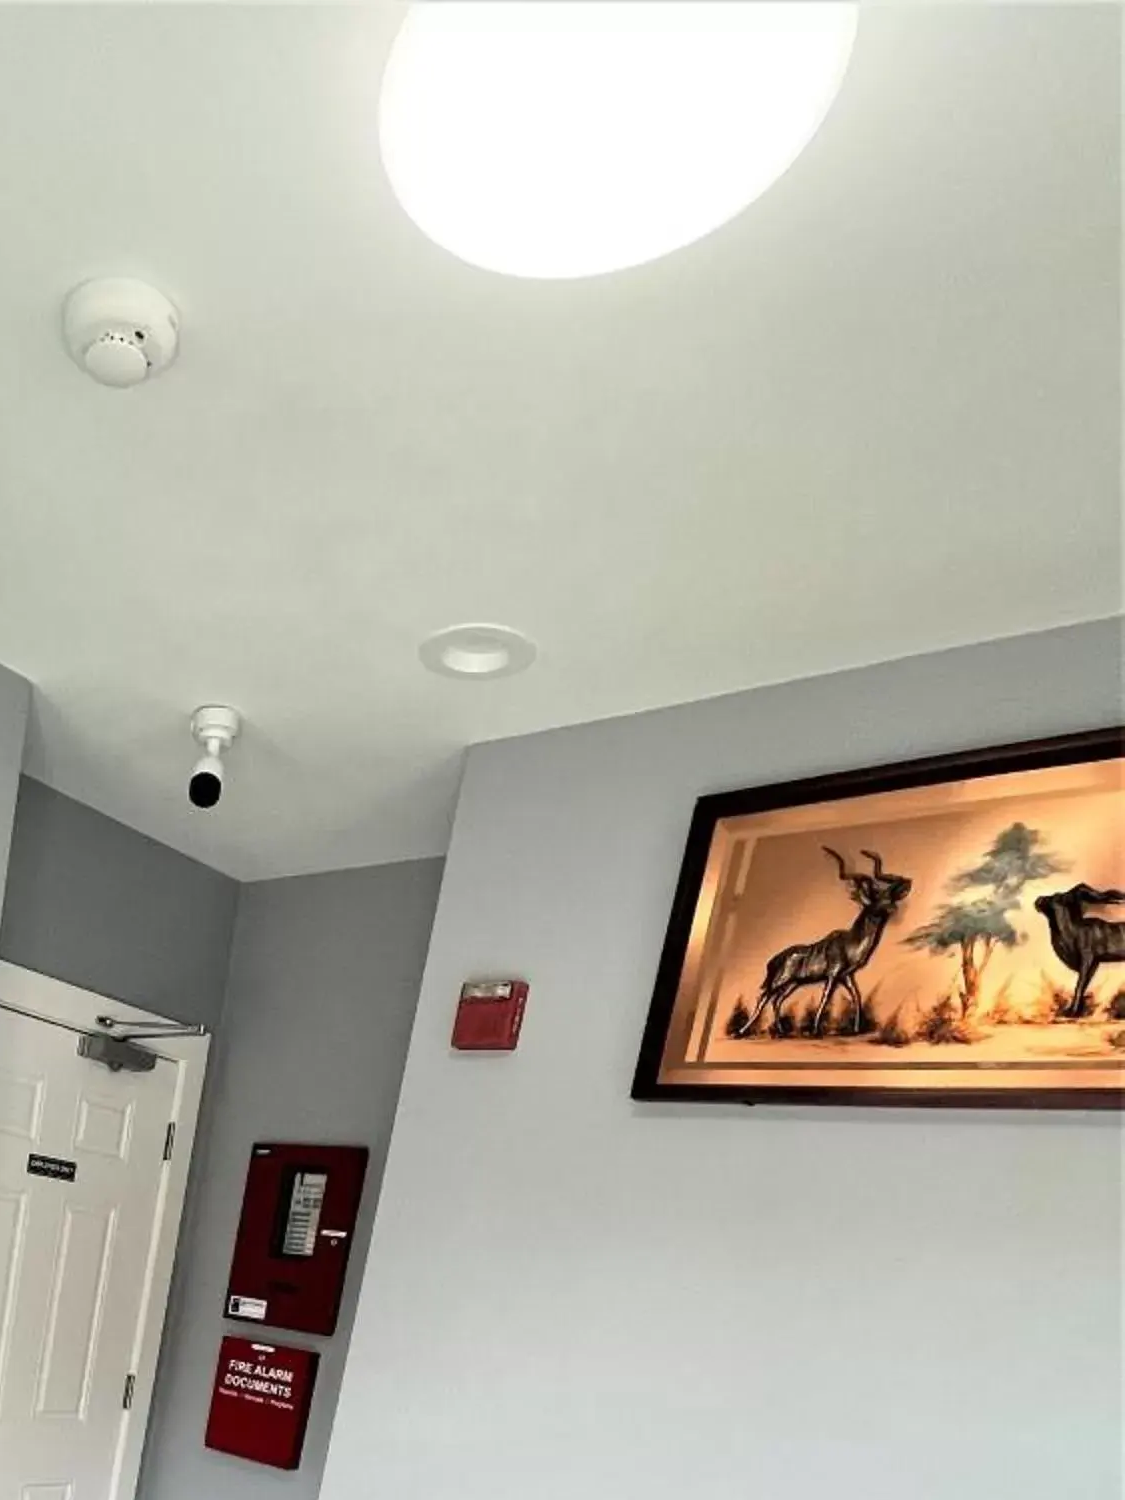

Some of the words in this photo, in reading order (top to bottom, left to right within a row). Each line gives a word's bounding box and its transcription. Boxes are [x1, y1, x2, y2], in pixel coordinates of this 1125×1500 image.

[229, 1360, 254, 1375] FIRE
[254, 1365, 294, 1383] ALARM
[225, 1373, 292, 1399] DOCUMENTS
